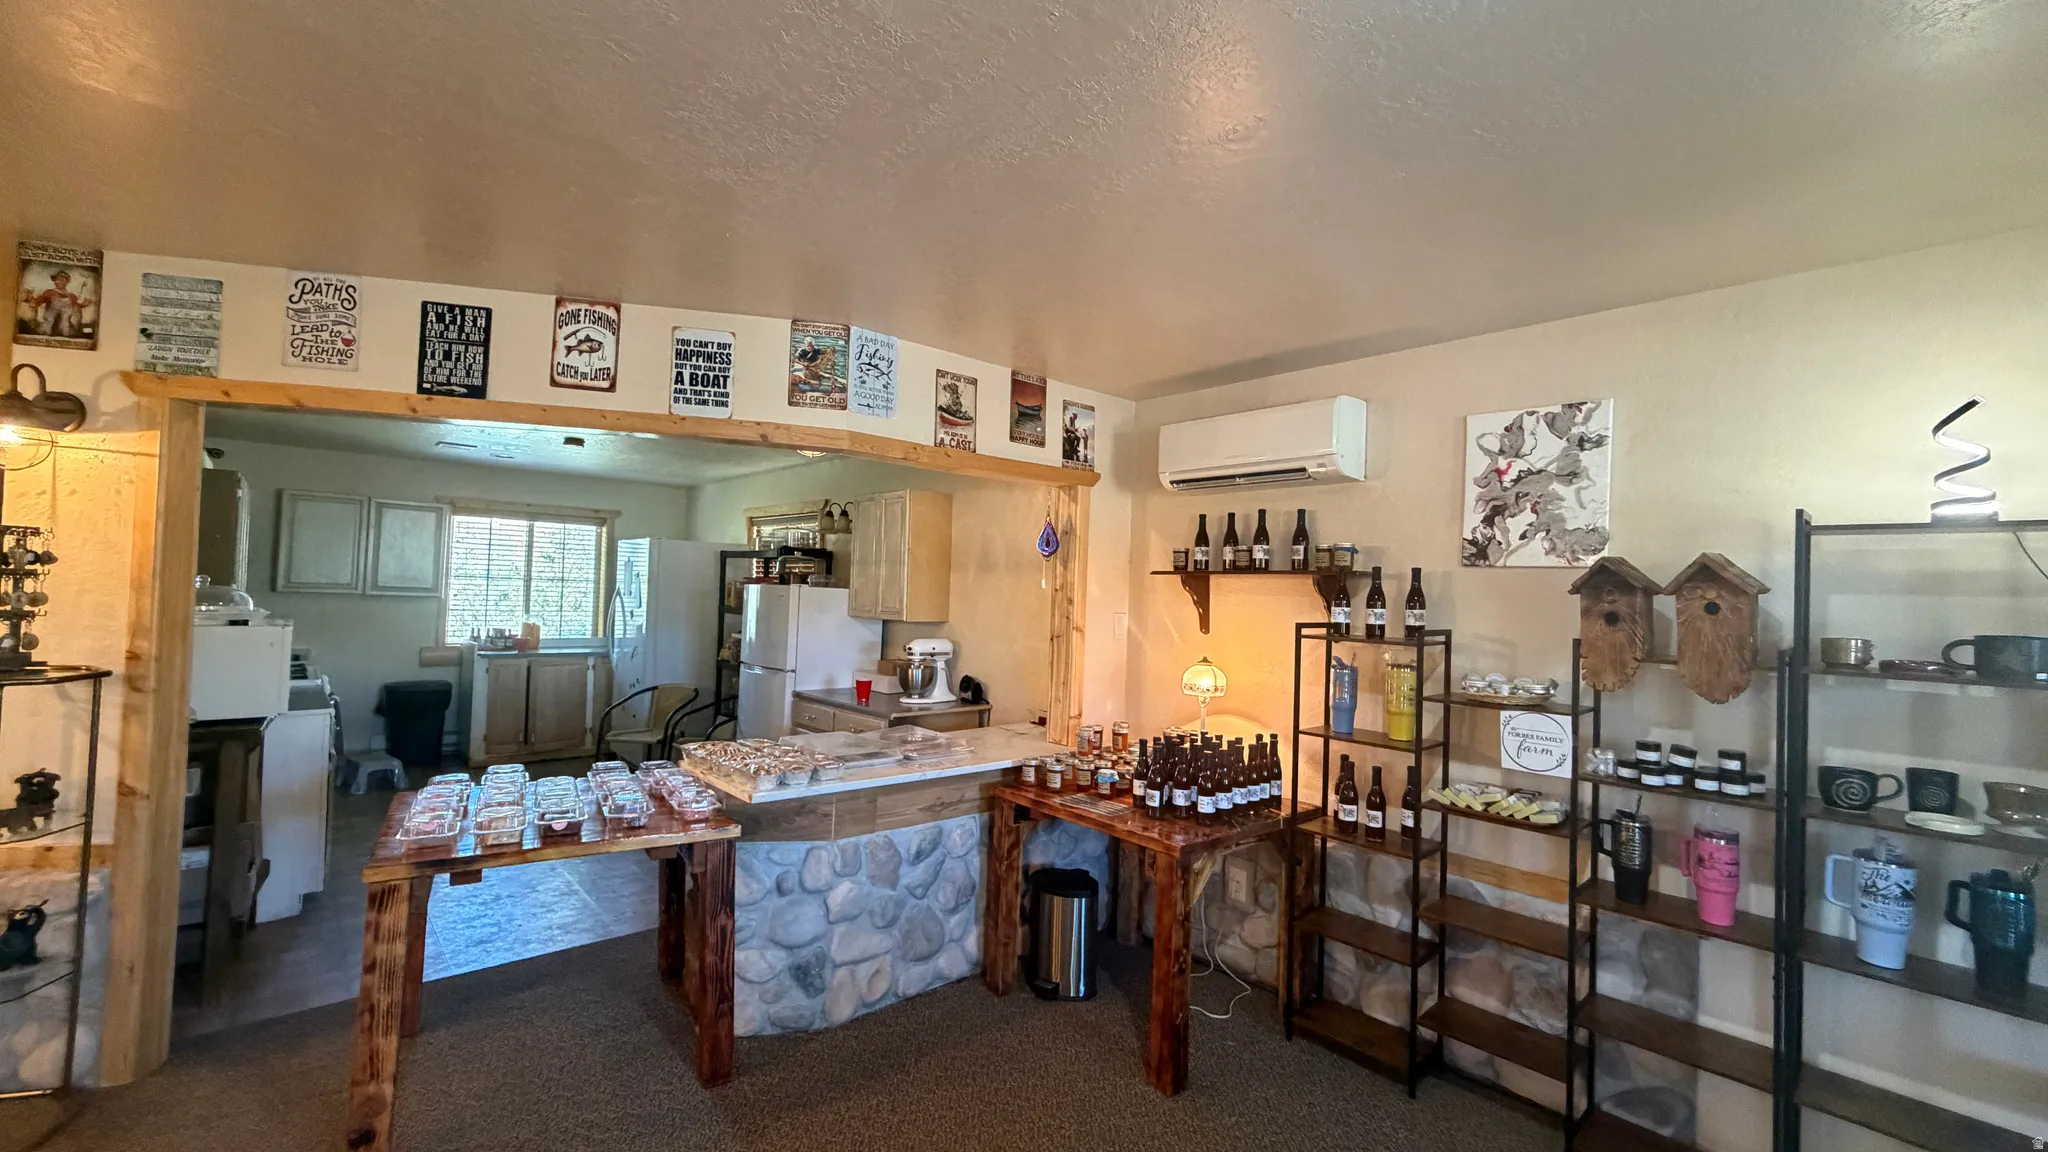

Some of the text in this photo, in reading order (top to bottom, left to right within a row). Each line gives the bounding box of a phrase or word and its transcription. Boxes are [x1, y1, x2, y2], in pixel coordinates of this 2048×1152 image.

[289, 278, 356, 311] PATHS
[312, 302, 339, 312] TAKE
[427, 304, 486, 317] GIVE A MAN
[427, 312, 486, 328] A FISH
[559, 308, 617, 336] GONE FISHING
[291, 324, 342, 338] LEAD to
[426, 322, 444, 331] AND
[464, 326, 484, 335] WILL
[312, 334, 338, 345] THE
[444, 331, 458, 339] FOR
[469, 334, 485, 342] DAY
[865, 336, 879, 345] BAD
[880, 340, 895, 349] DAY
[291, 338, 354, 359] FISHING
[426, 341, 449, 351] TEACH
[452, 344, 465, 352] HIM
[676, 338, 732, 351] YOU CAN'T BUY
[301, 356, 348, 365] HOLE
[425, 349, 483, 364] TO FISH
[675, 348, 732, 366] HAPPINESS
[855, 344, 893, 368] Fishing
[424, 359, 439, 367] AND
[441, 361, 454, 369] YOU
[457, 362, 469, 370] GET
[675, 362, 688, 370] BUT
[703, 365, 716, 373] CAN
[436, 367, 449, 376] HIM
[453, 369, 466, 377] FOR
[470, 370, 482, 378] THE
[556, 362, 611, 382] CATCH you LATER
[423, 374, 482, 386] ENTIRE WEEKEND
[674, 371, 730, 390] A BOAT
[673, 387, 687, 395] AND
[689, 389, 711, 397] THAT'S
[860, 392, 880, 401] GOOD
[881, 396, 893, 404] DAY
[673, 396, 729, 408] OF THE SAME THING
[940, 437, 972, 451] A CAST
[1010, 434, 1045, 446] HAPPY HOUR
[1507, 731, 1564, 744] FORBES FAMILY
[1517, 739, 1553, 759] farm
